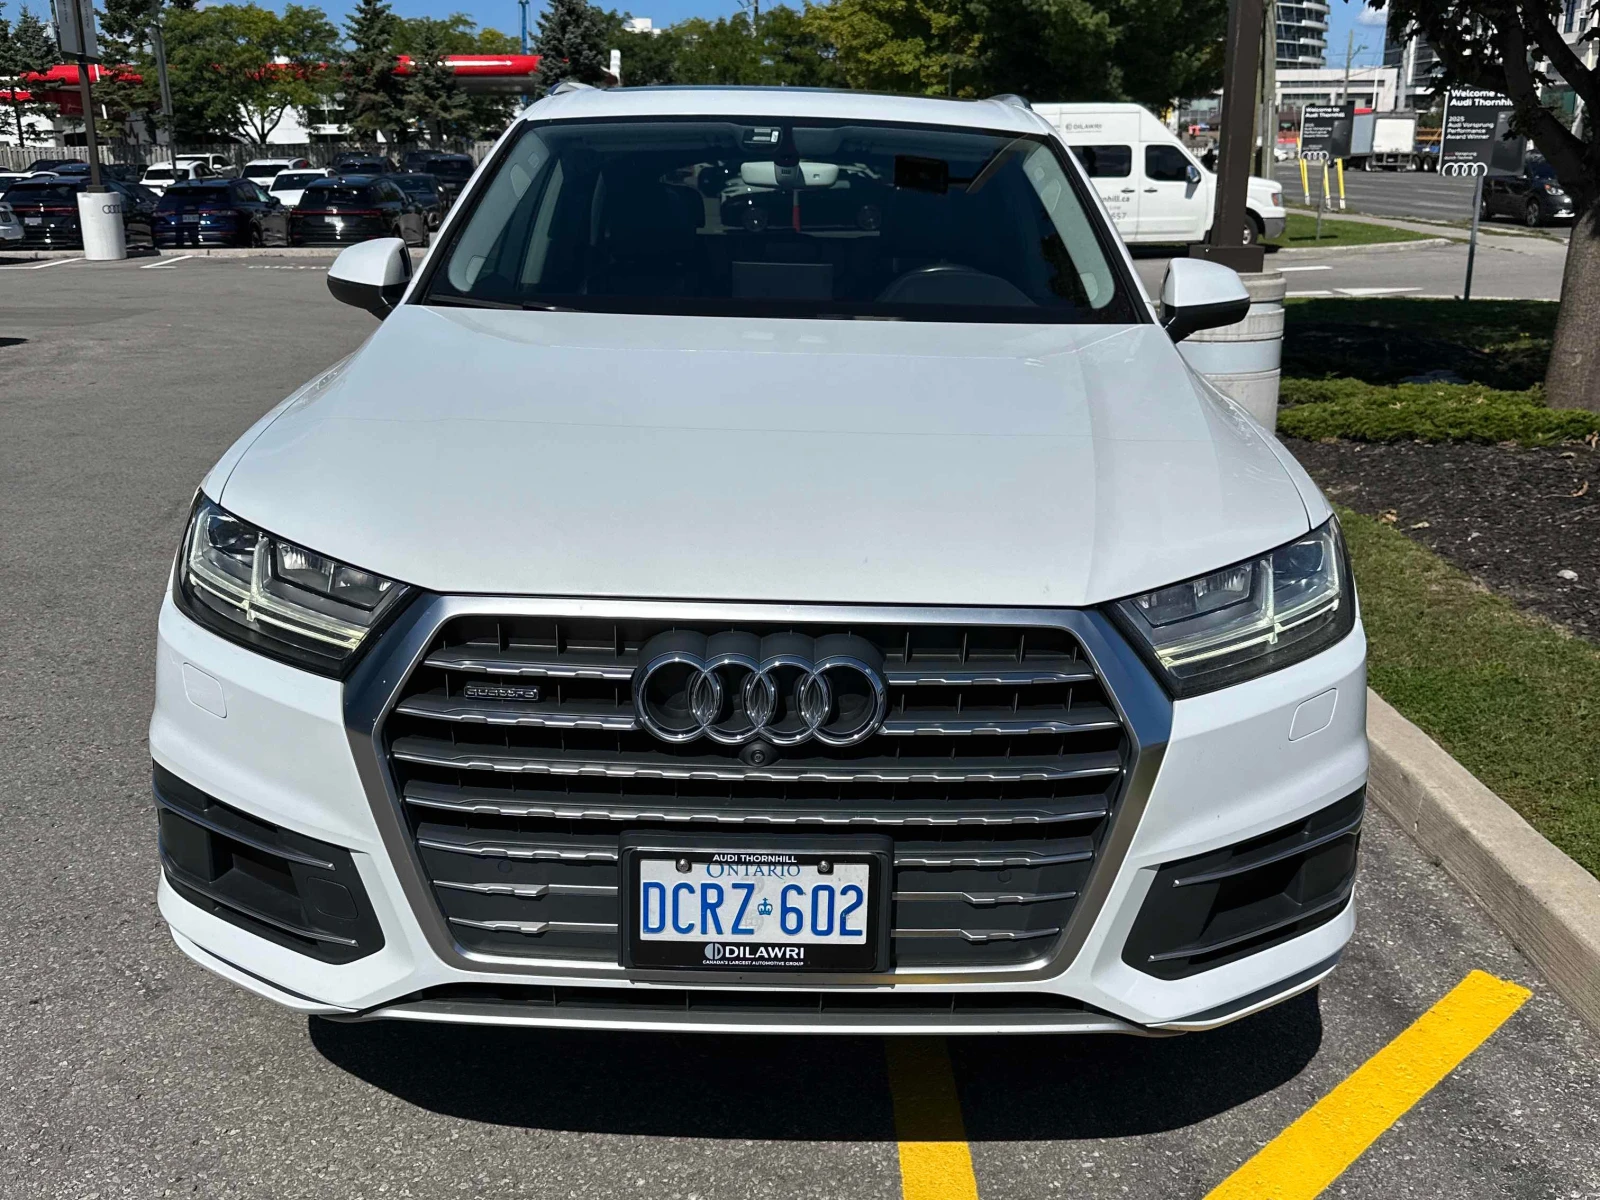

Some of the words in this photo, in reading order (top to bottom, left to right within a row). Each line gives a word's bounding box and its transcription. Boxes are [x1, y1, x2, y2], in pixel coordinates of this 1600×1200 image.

[1451, 89, 1495, 97] Welcome
[1474, 98, 1514, 106] Thornhi
[713, 854, 738, 862] AUDI
[740, 855, 797, 863] THORNHILL
[706, 861, 801, 880] ONTARIO
[643, 881, 755, 935] DCRZ
[780, 883, 864, 937] 602
[725, 945, 805, 959] DILAWRI
